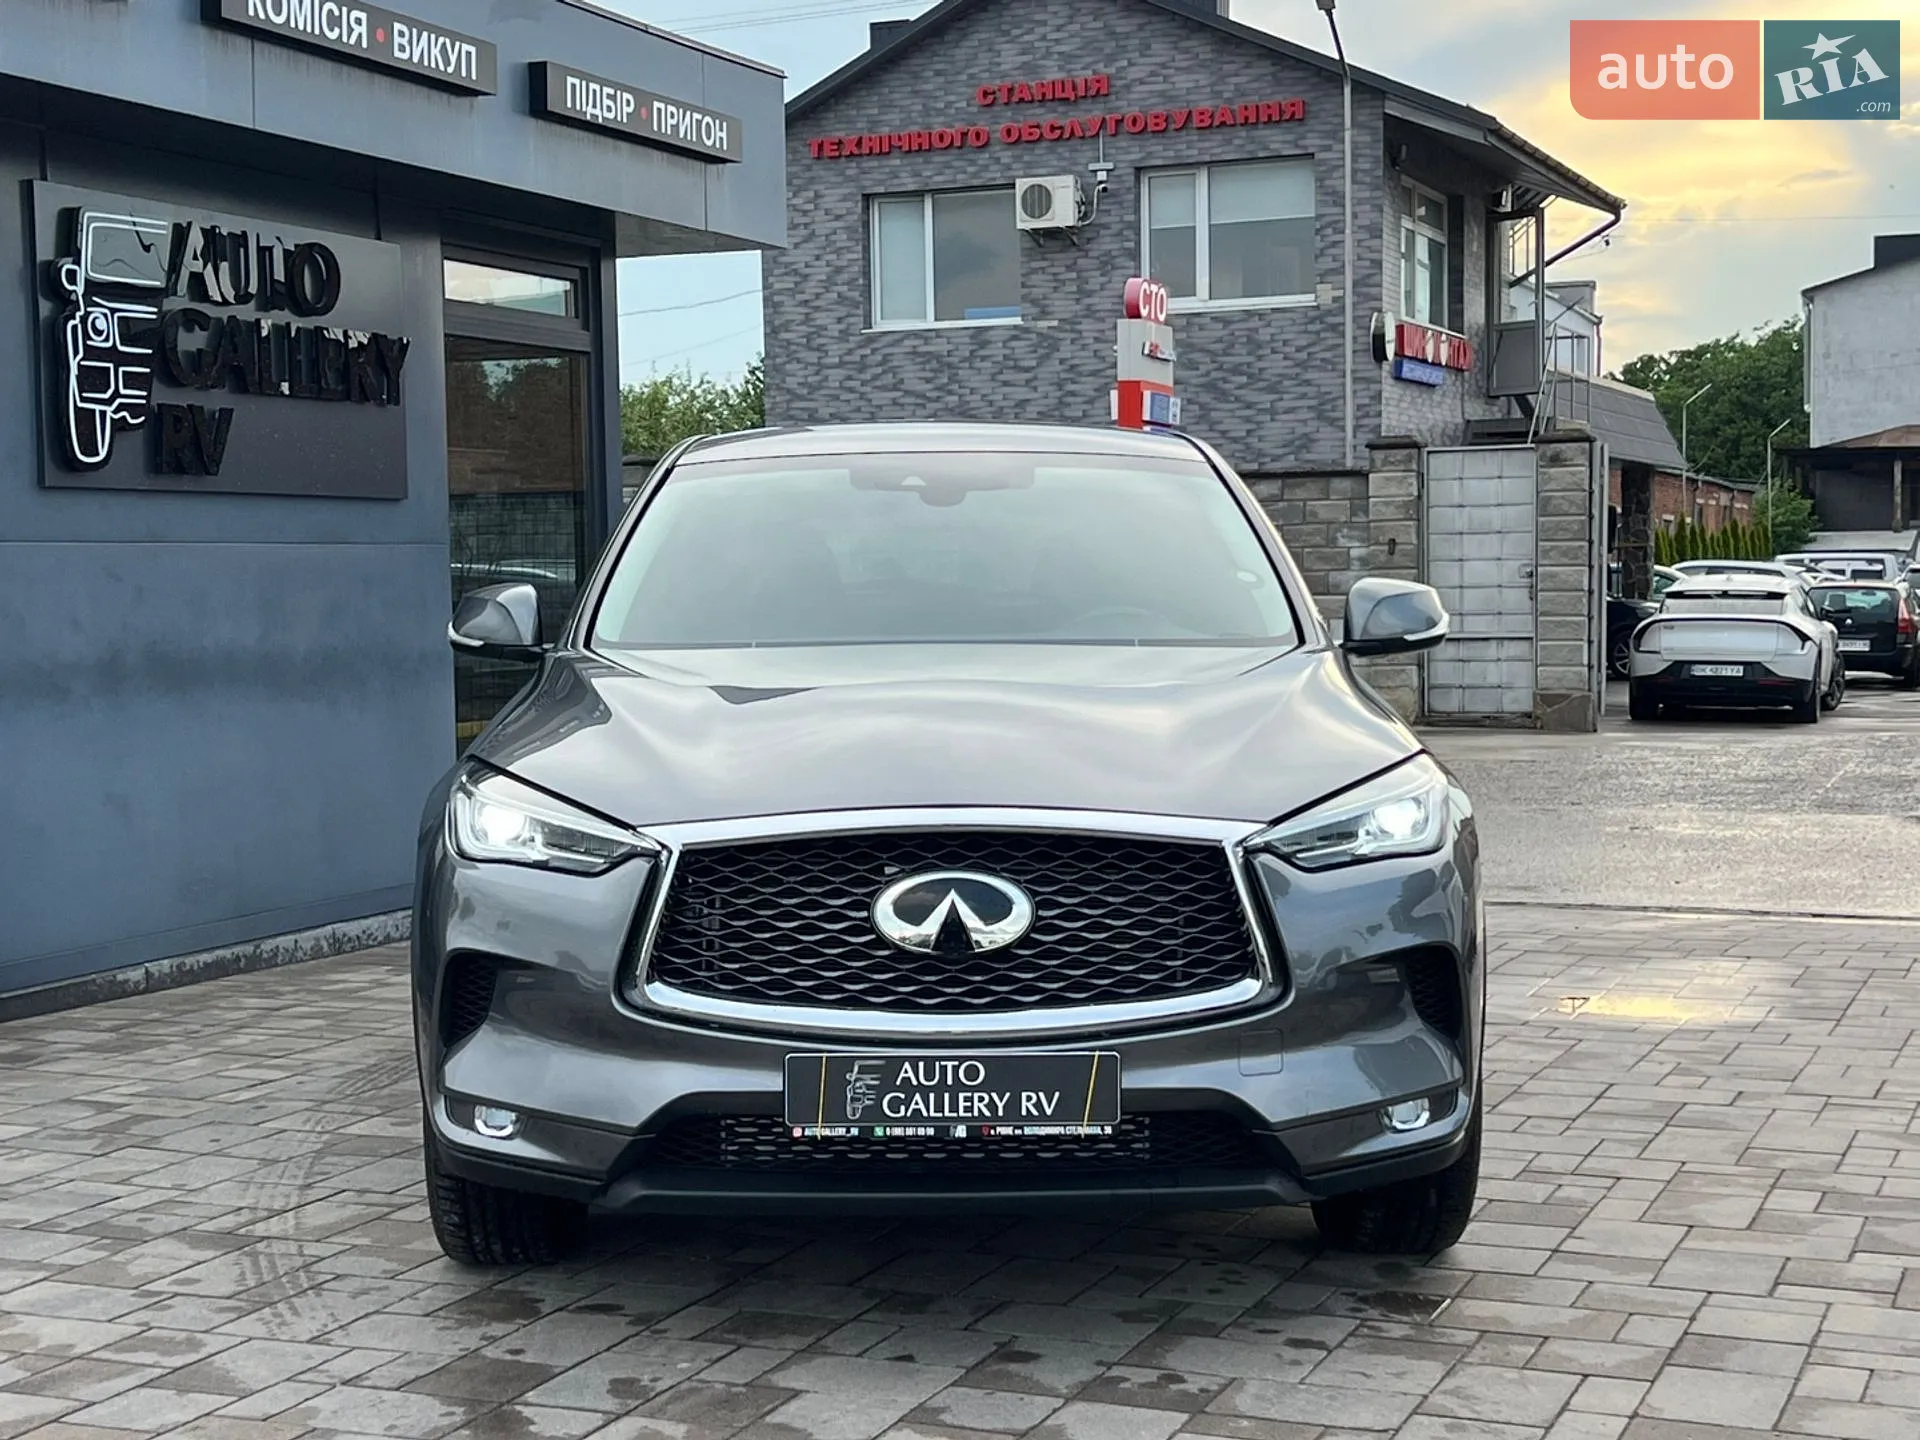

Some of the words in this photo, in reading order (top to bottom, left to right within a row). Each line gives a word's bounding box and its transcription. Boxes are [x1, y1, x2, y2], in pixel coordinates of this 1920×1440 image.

[392, 21, 478, 81] ВИКУП
[565, 75, 635, 123] ПІДБІР
[652, 100, 728, 151] ПРИГОН
[975, 73, 1110, 107] СТАНЦІЯ
[807, 126, 991, 160] ТЕХНІЧНОГО
[999, 98, 1305, 144] ОБСЛУГОВУВАННЯ
[167, 221, 341, 318] AUTO
[1139, 281, 1167, 322] СТО
[152, 402, 235, 477] RV
[895, 1061, 986, 1086] AUTO
[881, 1091, 1012, 1118] GALLERY
[1020, 1091, 1060, 1116] RV
